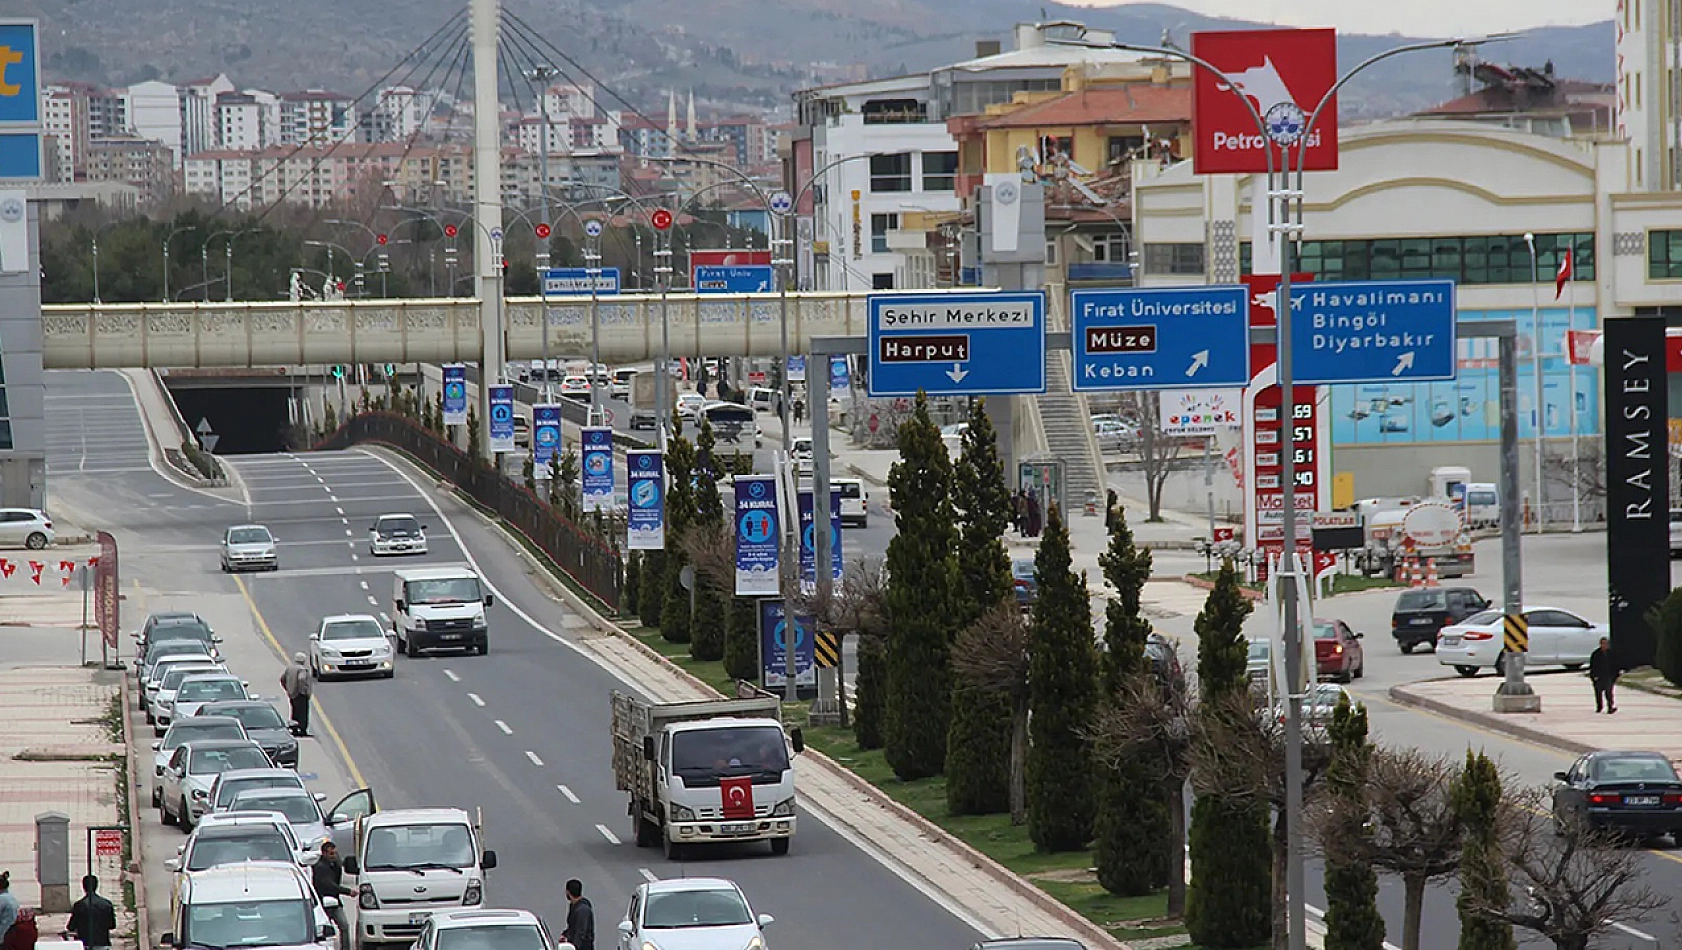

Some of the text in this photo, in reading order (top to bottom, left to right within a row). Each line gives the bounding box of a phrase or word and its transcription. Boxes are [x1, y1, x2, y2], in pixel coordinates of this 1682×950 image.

[1213, 131, 1266, 151] Petro
[1313, 290, 1443, 307] Havalimanı
[1083, 298, 1237, 318] Fırat Üniversitesi
[885, 308, 1029, 326] Şehir Merkezi
[1313, 311, 1386, 330] Bingöl
[1091, 331, 1151, 348] Müze
[1313, 332, 1434, 354] Diyarbakır
[885, 342, 965, 360] Harput
[1085, 362, 1153, 378] Keban
[1291, 404, 1312, 419] .69
[1291, 427, 1312, 441] .57
[1622, 348, 1652, 520] RAMSEY
[1291, 449, 1313, 463] .61
[1291, 471, 1314, 486] .40
